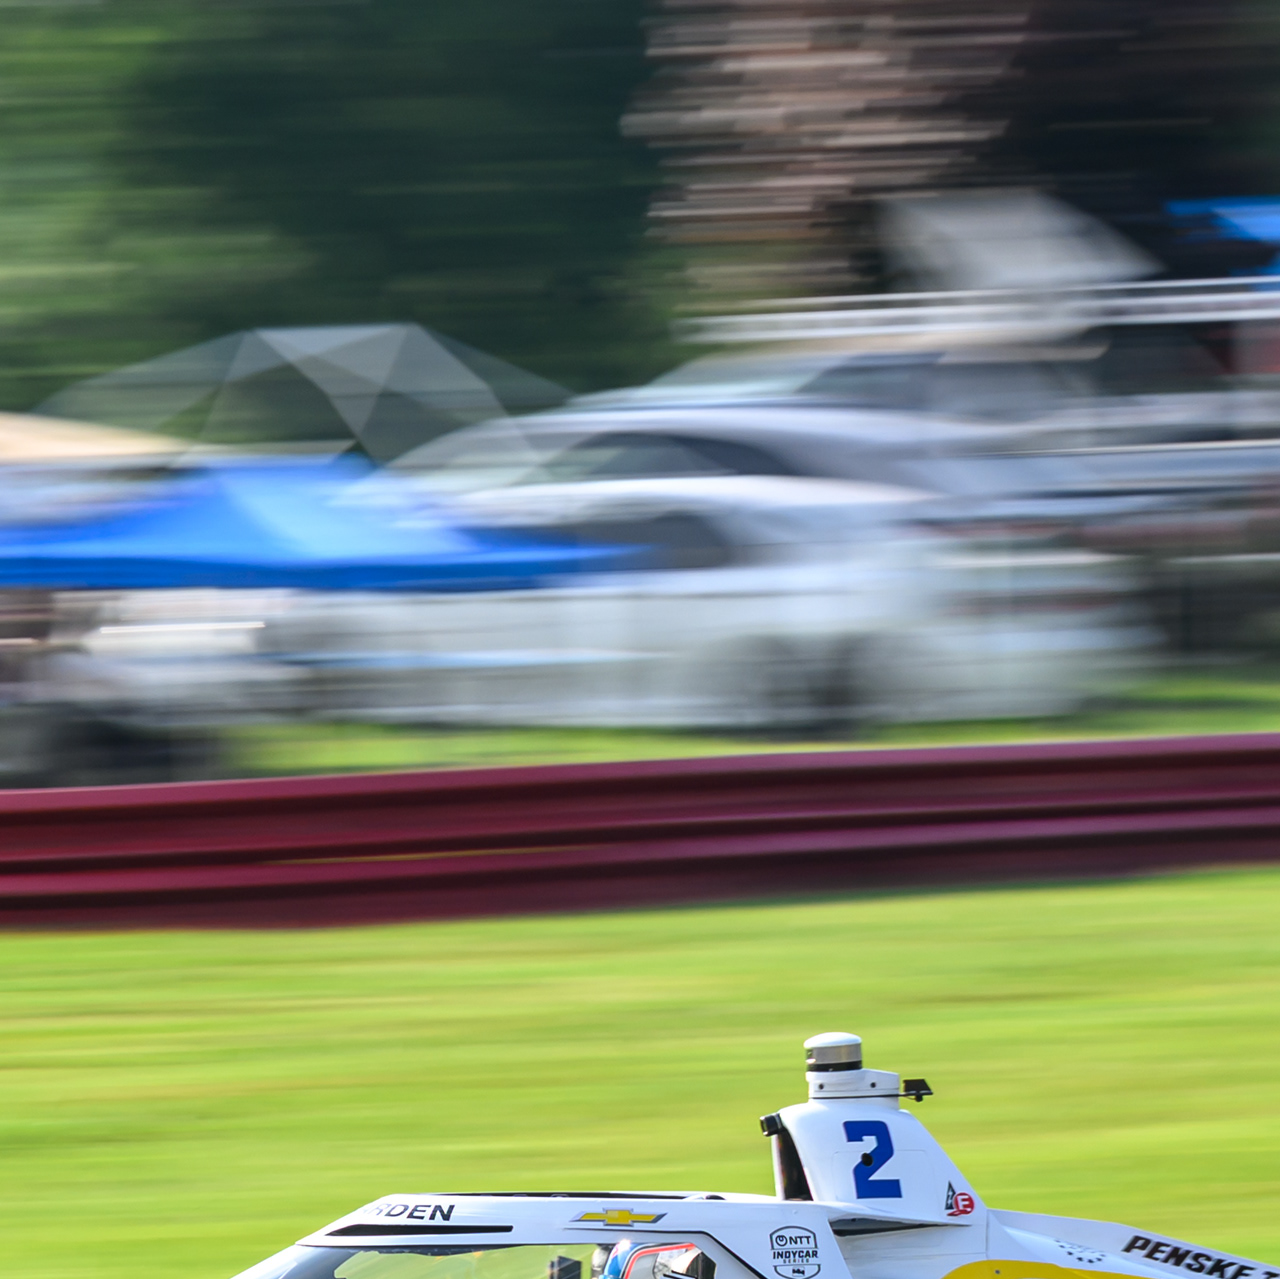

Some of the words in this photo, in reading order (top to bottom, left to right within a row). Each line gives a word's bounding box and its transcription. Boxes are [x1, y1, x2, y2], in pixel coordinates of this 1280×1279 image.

[843, 1120, 903, 1199] 2
[788, 1236, 811, 1245] NTT
[773, 1250, 819, 1259] INDYCAR
